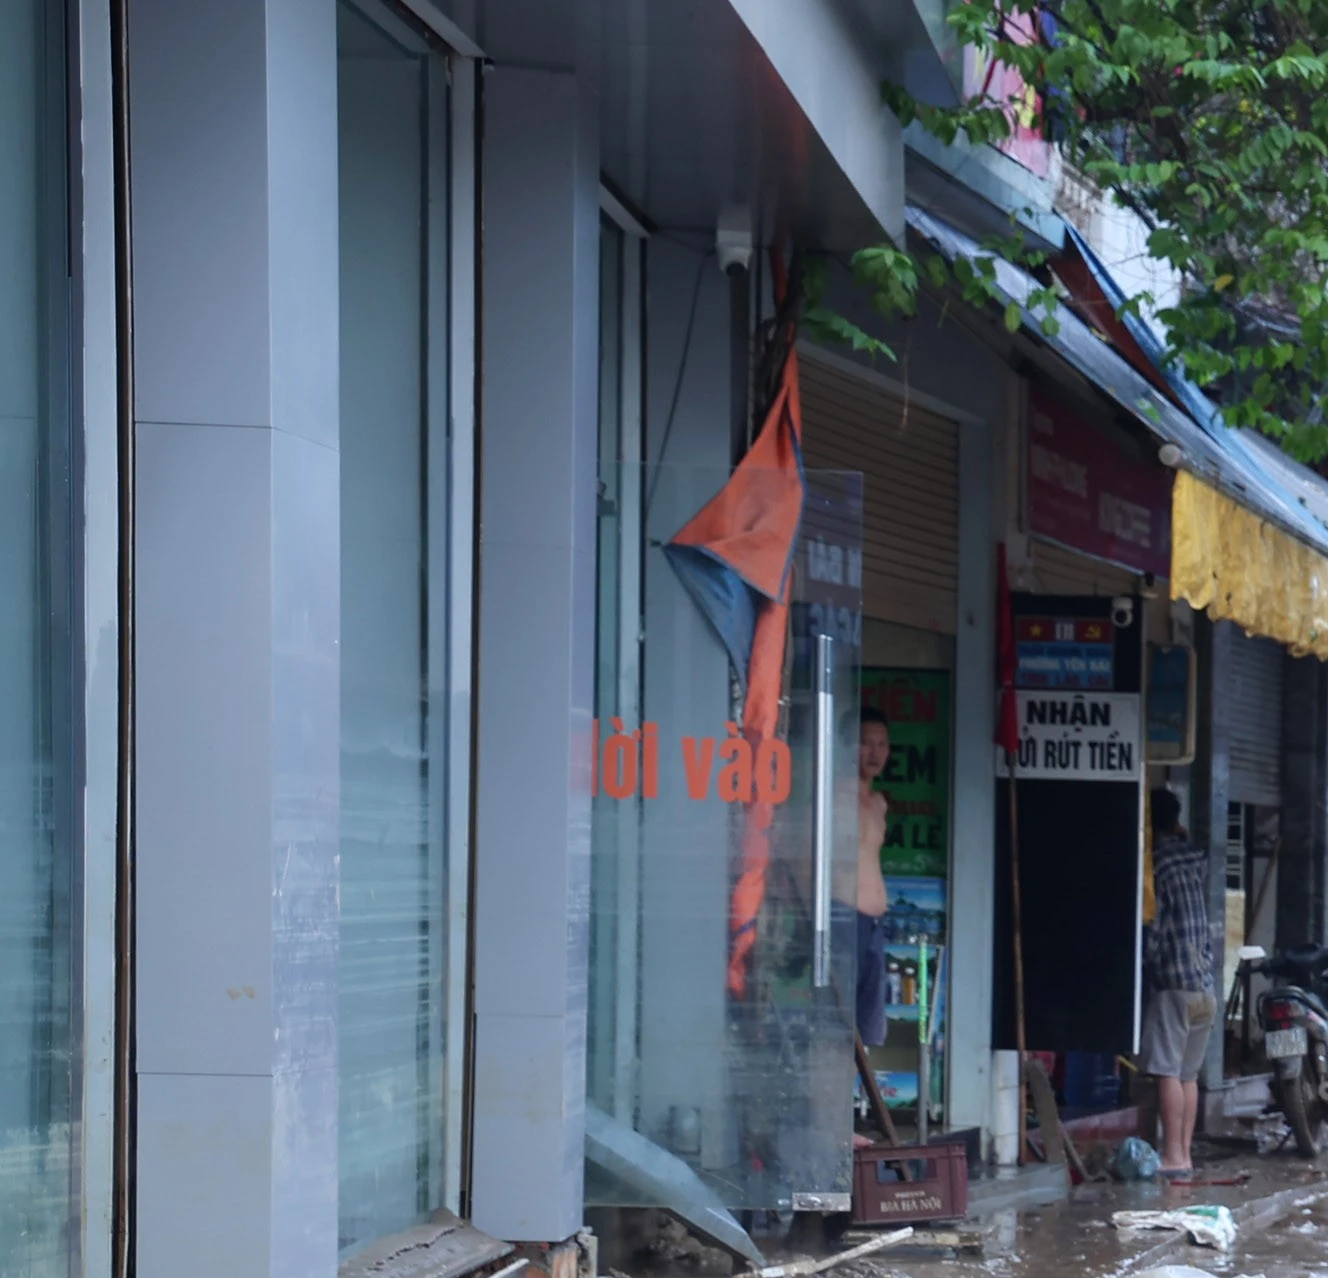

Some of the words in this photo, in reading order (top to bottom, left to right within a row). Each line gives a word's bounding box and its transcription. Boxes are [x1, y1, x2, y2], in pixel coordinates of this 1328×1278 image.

[1026, 694, 1111, 733] NHẬN
[592, 716, 659, 800] ời
[681, 721, 793, 804] vào
[1043, 731, 1082, 770] RÚT
[1088, 730, 1133, 771] TIỀN
